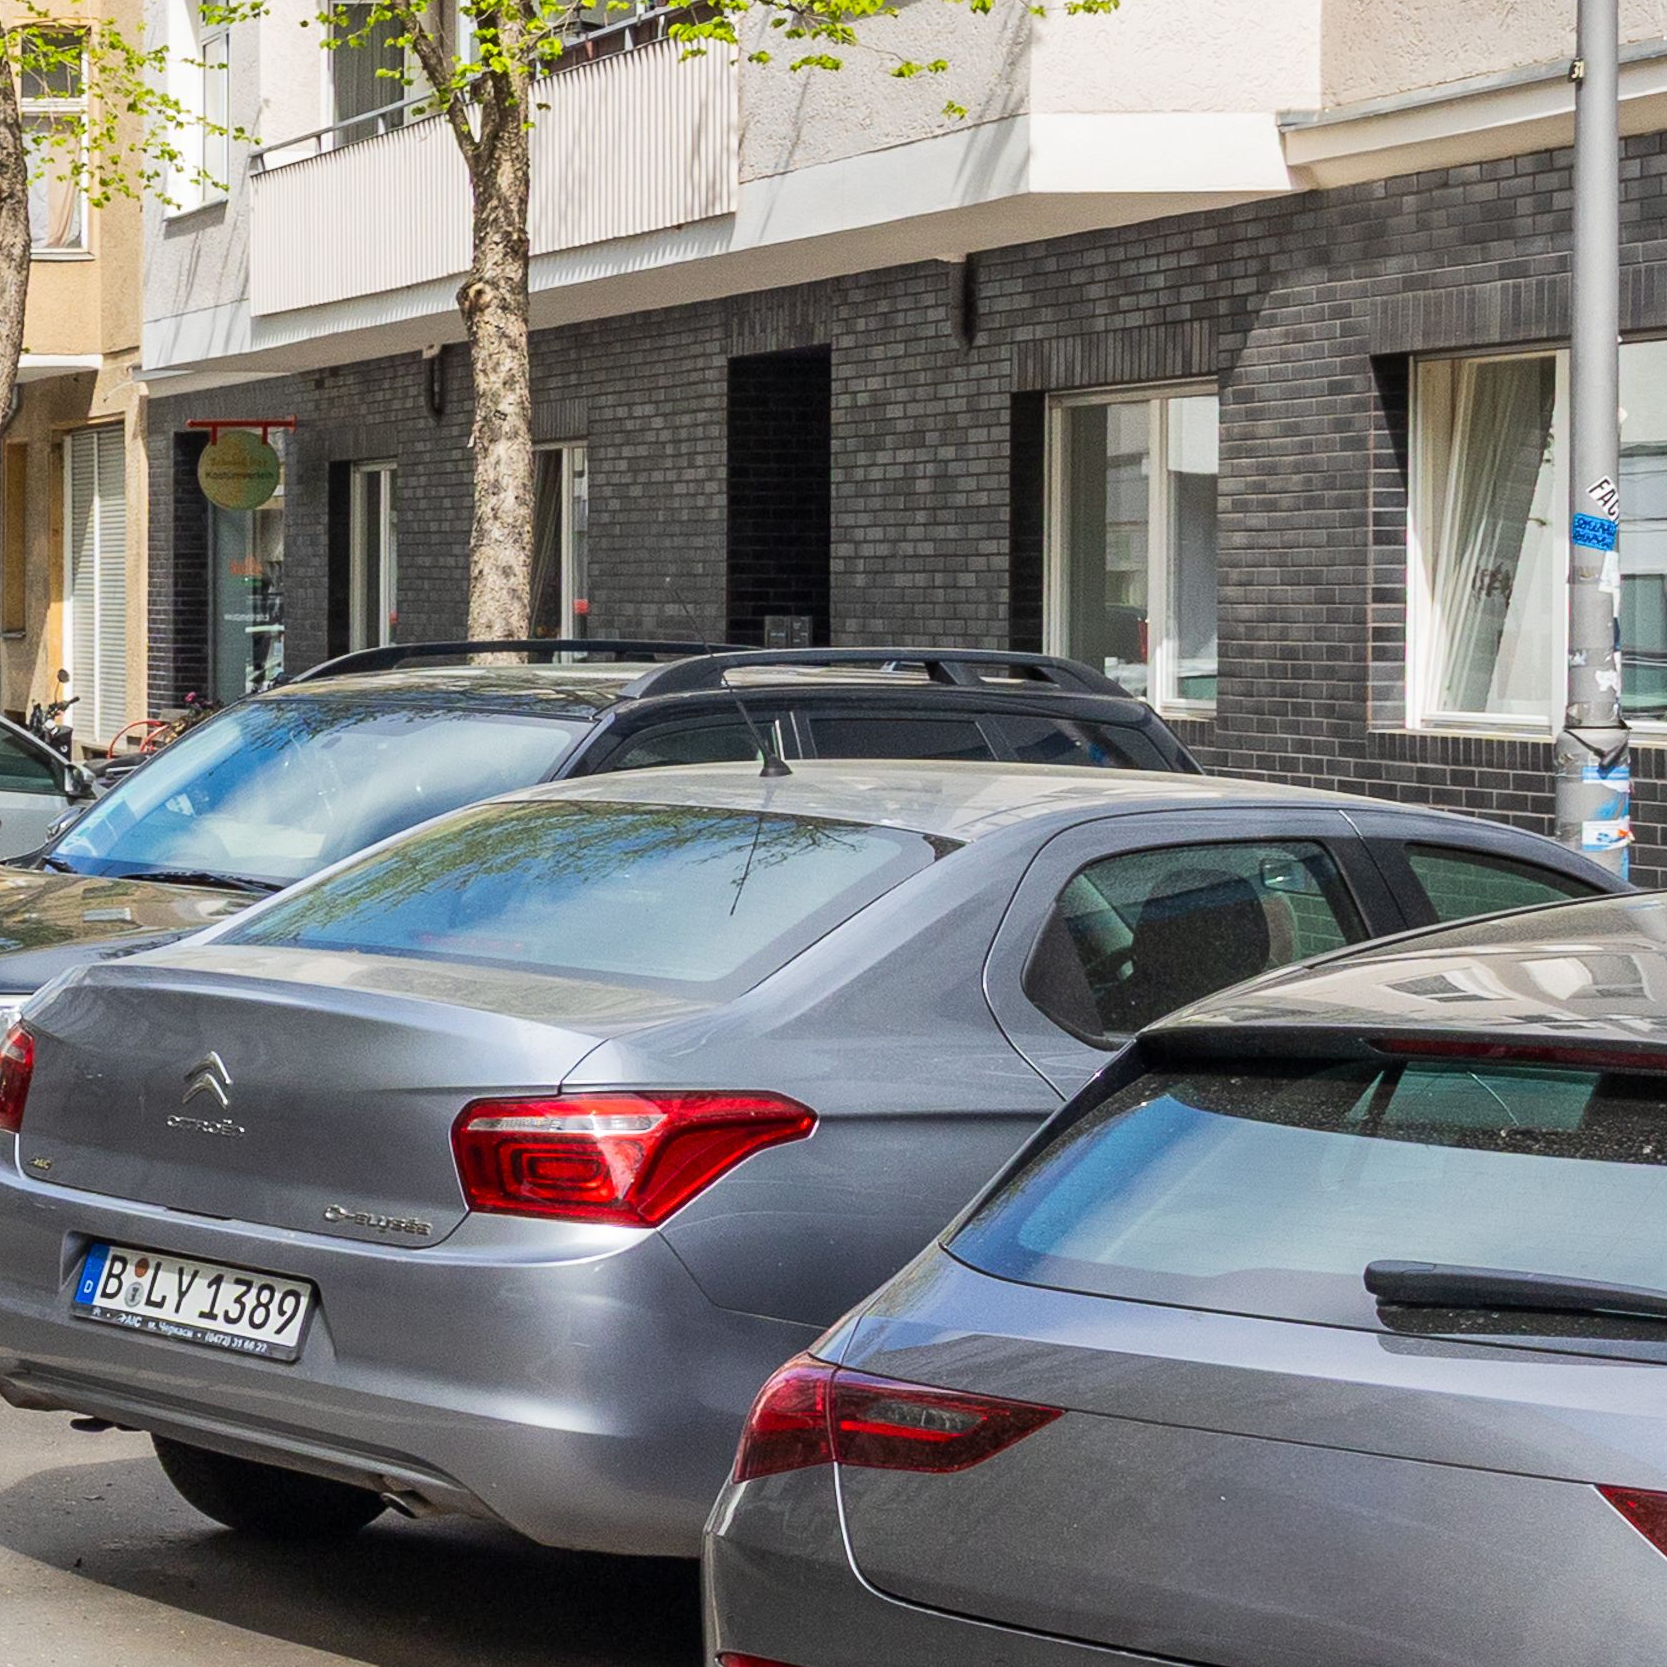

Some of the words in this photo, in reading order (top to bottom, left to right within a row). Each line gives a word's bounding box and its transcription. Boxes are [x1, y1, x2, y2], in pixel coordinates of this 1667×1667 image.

[100, 1254, 129, 1300] B
[144, 1261, 200, 1314] LY
[198, 1273, 302, 1335] 1389
